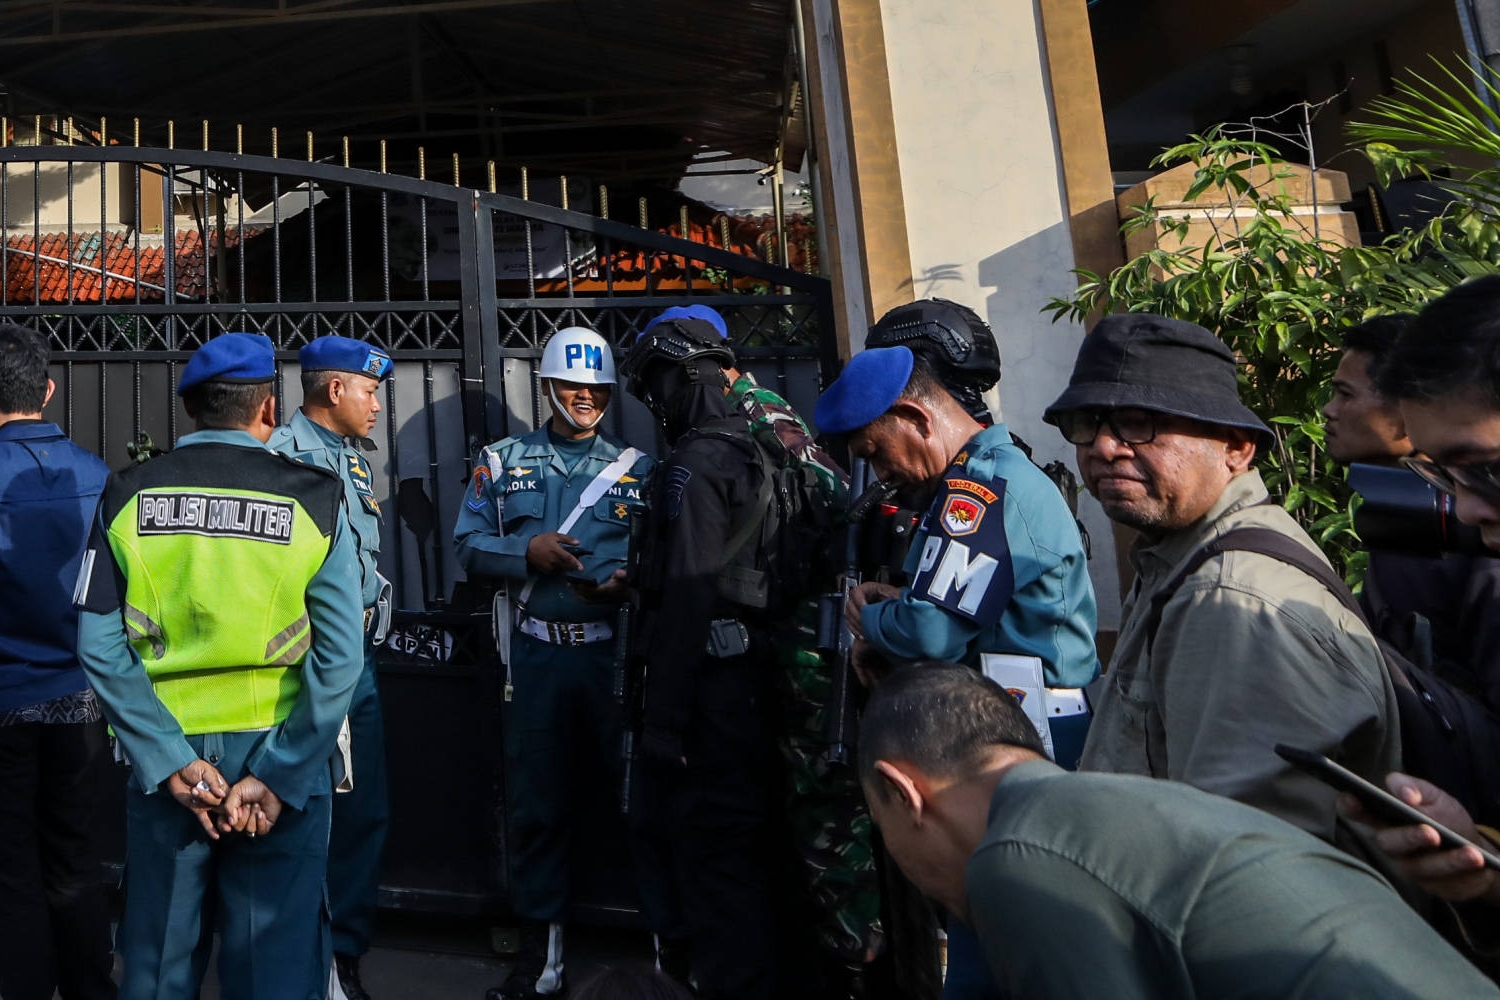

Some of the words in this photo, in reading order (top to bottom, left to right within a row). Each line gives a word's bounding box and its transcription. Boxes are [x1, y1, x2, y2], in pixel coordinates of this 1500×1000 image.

[565, 343, 603, 372] PM
[605, 486, 622, 497] NI
[141, 497, 206, 528] POLISI
[207, 498, 292, 538] MILITER
[911, 534, 999, 616] PM
